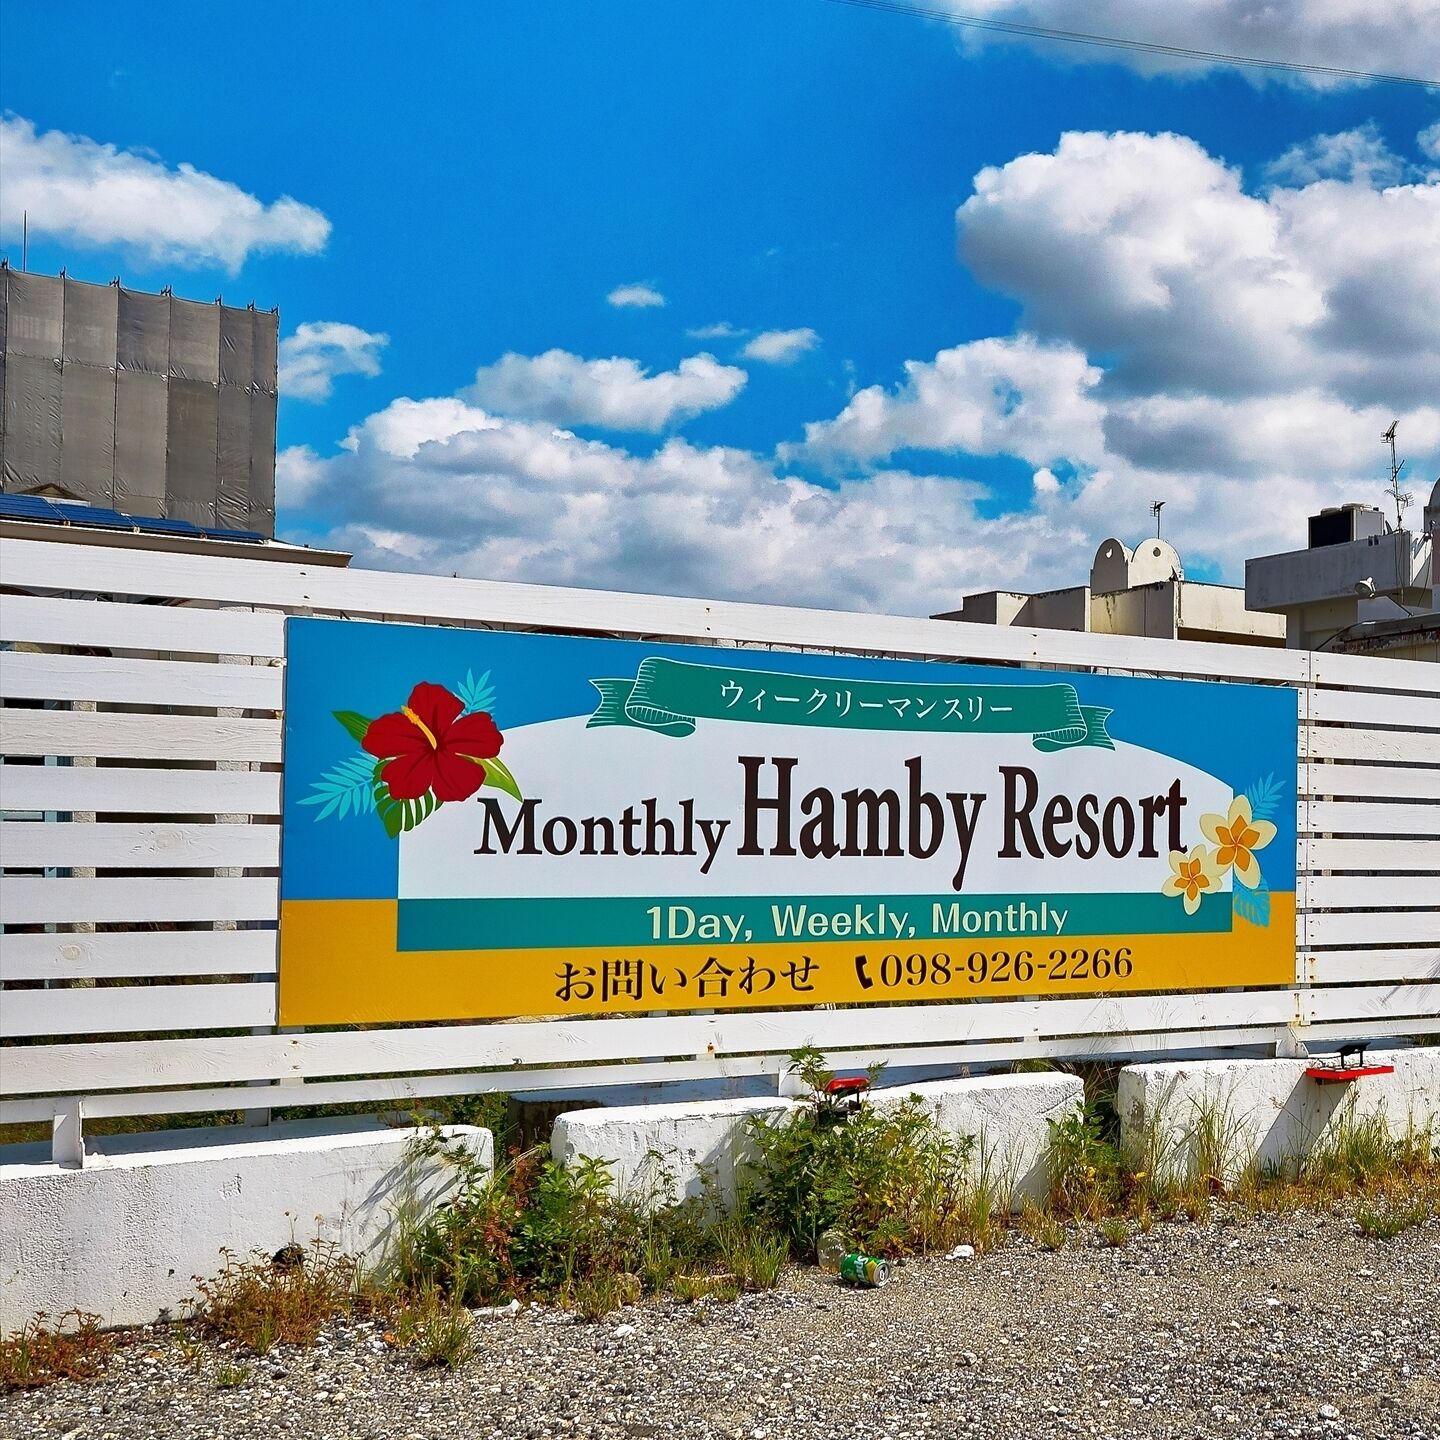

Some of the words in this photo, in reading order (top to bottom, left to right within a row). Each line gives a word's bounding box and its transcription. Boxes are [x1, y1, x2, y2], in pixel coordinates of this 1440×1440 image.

[720, 679, 1013, 722] ウィークリーマンスリー
[473, 797, 731, 875] Monthly
[736, 755, 987, 892] Hamby
[998, 765, 1188, 860] Resort
[646, 905, 753, 943] 1Day,
[771, 903, 916, 939] Weekly,
[932, 901, 1068, 935] Monthly
[554, 955, 820, 1002] お問い合わせ
[880, 947, 1133, 987] 098-926-2266
